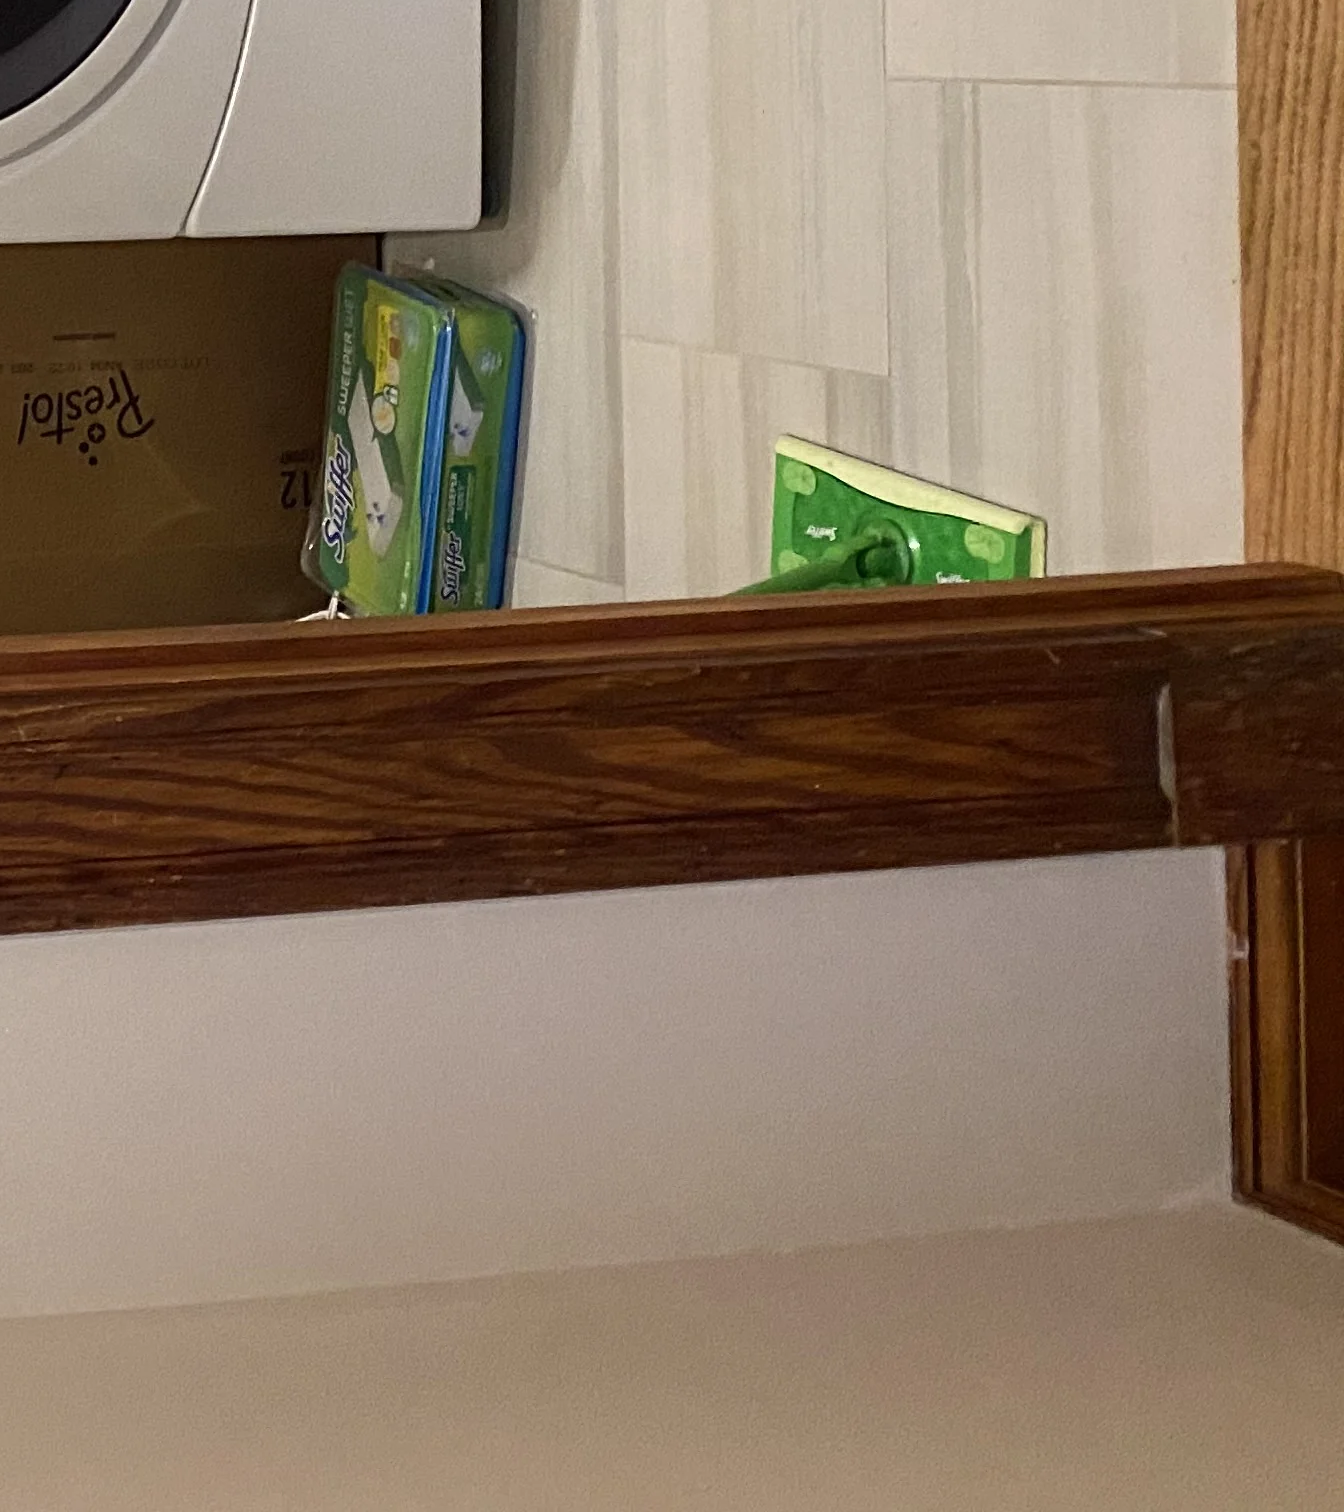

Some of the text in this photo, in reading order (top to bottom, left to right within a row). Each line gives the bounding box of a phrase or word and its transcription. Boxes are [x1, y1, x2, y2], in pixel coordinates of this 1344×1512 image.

[16, 370, 154, 446] Presto!
[337, 331, 353, 416] SWEEPER
[281, 470, 312, 509] 12
[322, 434, 354, 564] Swiffer
[440, 532, 466, 604] Swiffer
